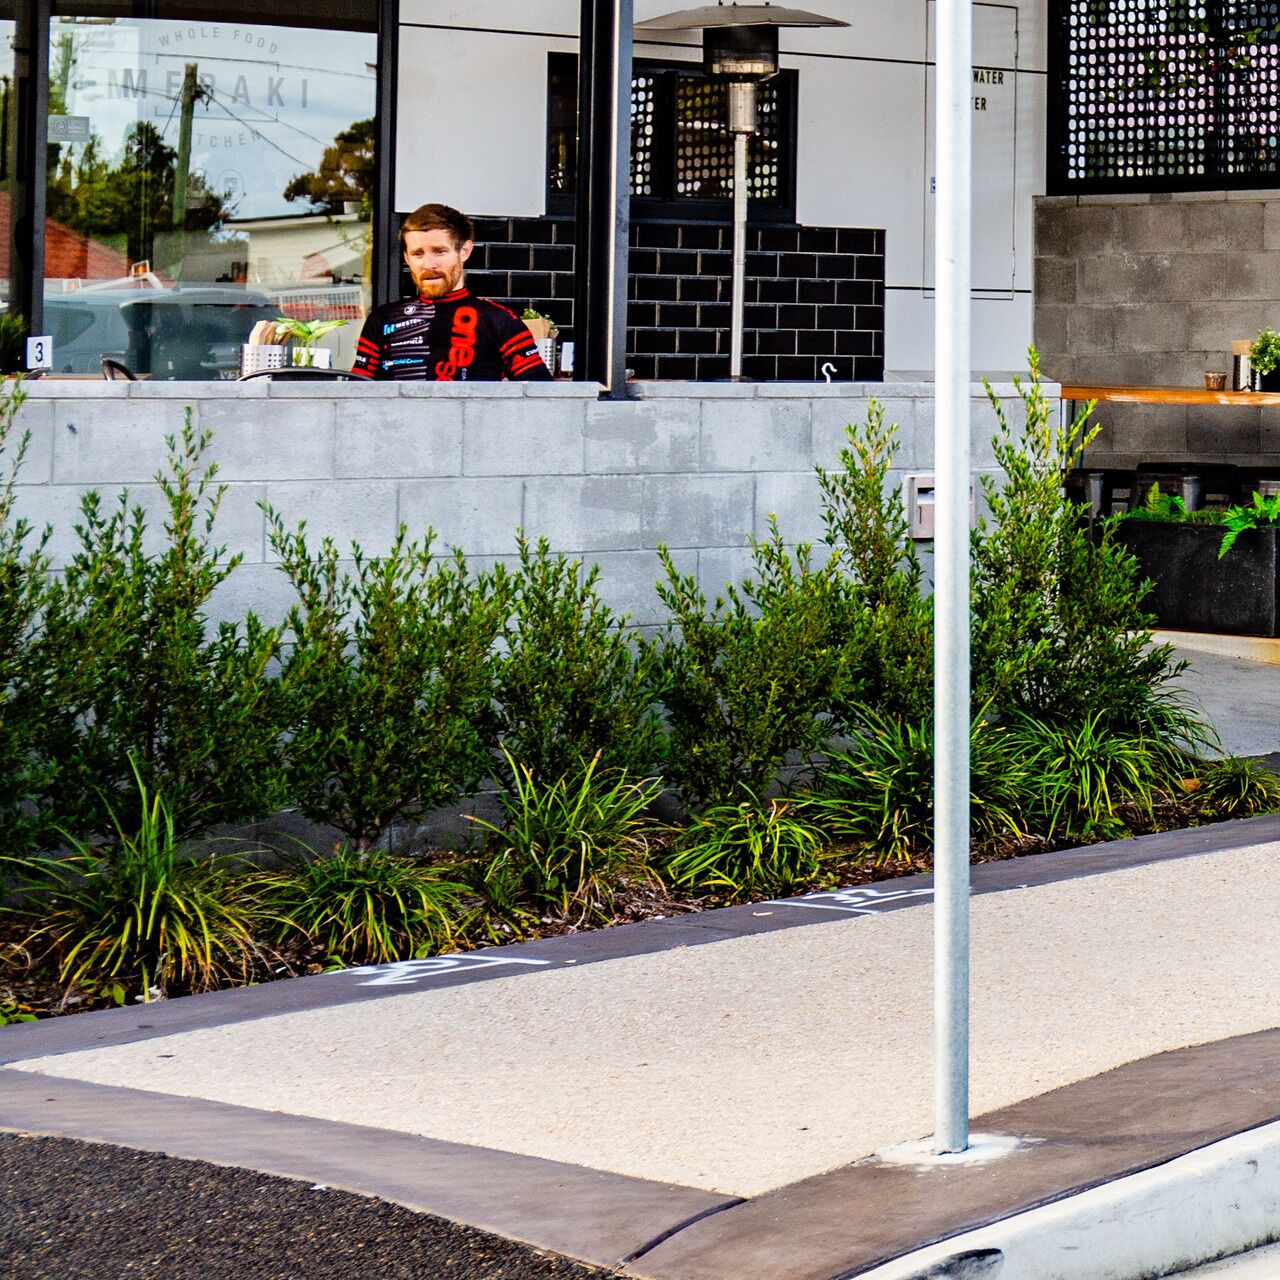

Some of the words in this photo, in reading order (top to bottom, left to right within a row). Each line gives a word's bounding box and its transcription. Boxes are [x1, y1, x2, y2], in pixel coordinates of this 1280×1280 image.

[158, 27, 220, 48] WHOLE
[233, 29, 278, 55] FOOD
[972, 70, 1004, 85] WATER
[35, 342, 43, 362] 3
